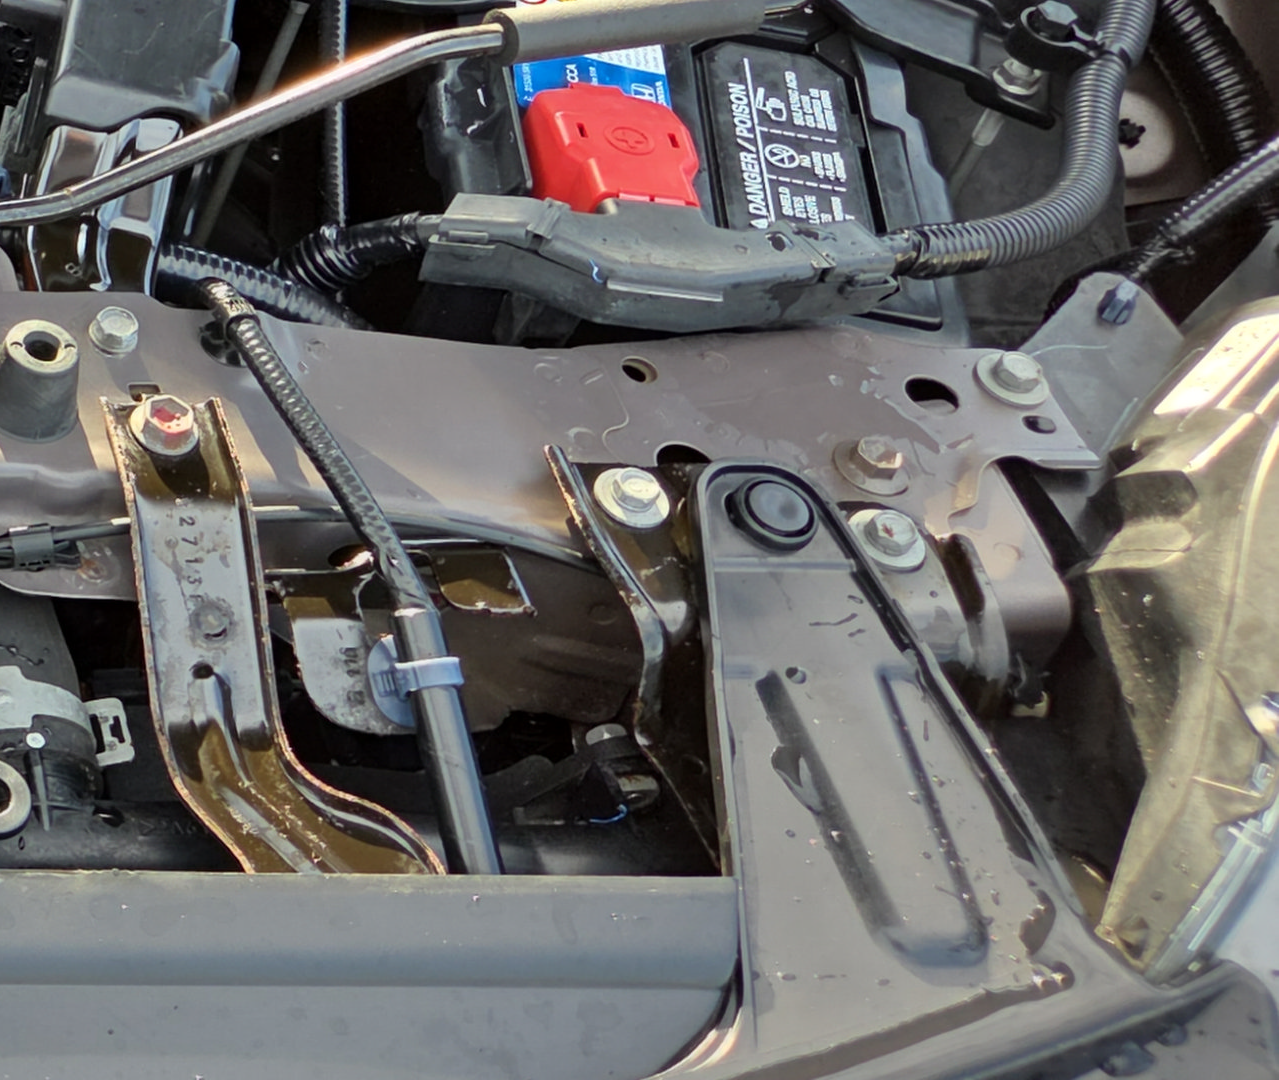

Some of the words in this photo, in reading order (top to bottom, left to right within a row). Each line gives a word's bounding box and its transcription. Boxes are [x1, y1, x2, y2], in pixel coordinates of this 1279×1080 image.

[565, 63, 579, 83] CCA
[728, 82, 755, 139] POISON
[740, 151, 768, 216] DANGER
[778, 186, 794, 216] SHIELD
[792, 196, 806, 218] EYES
[804, 194, 820, 224] LOSIVE
